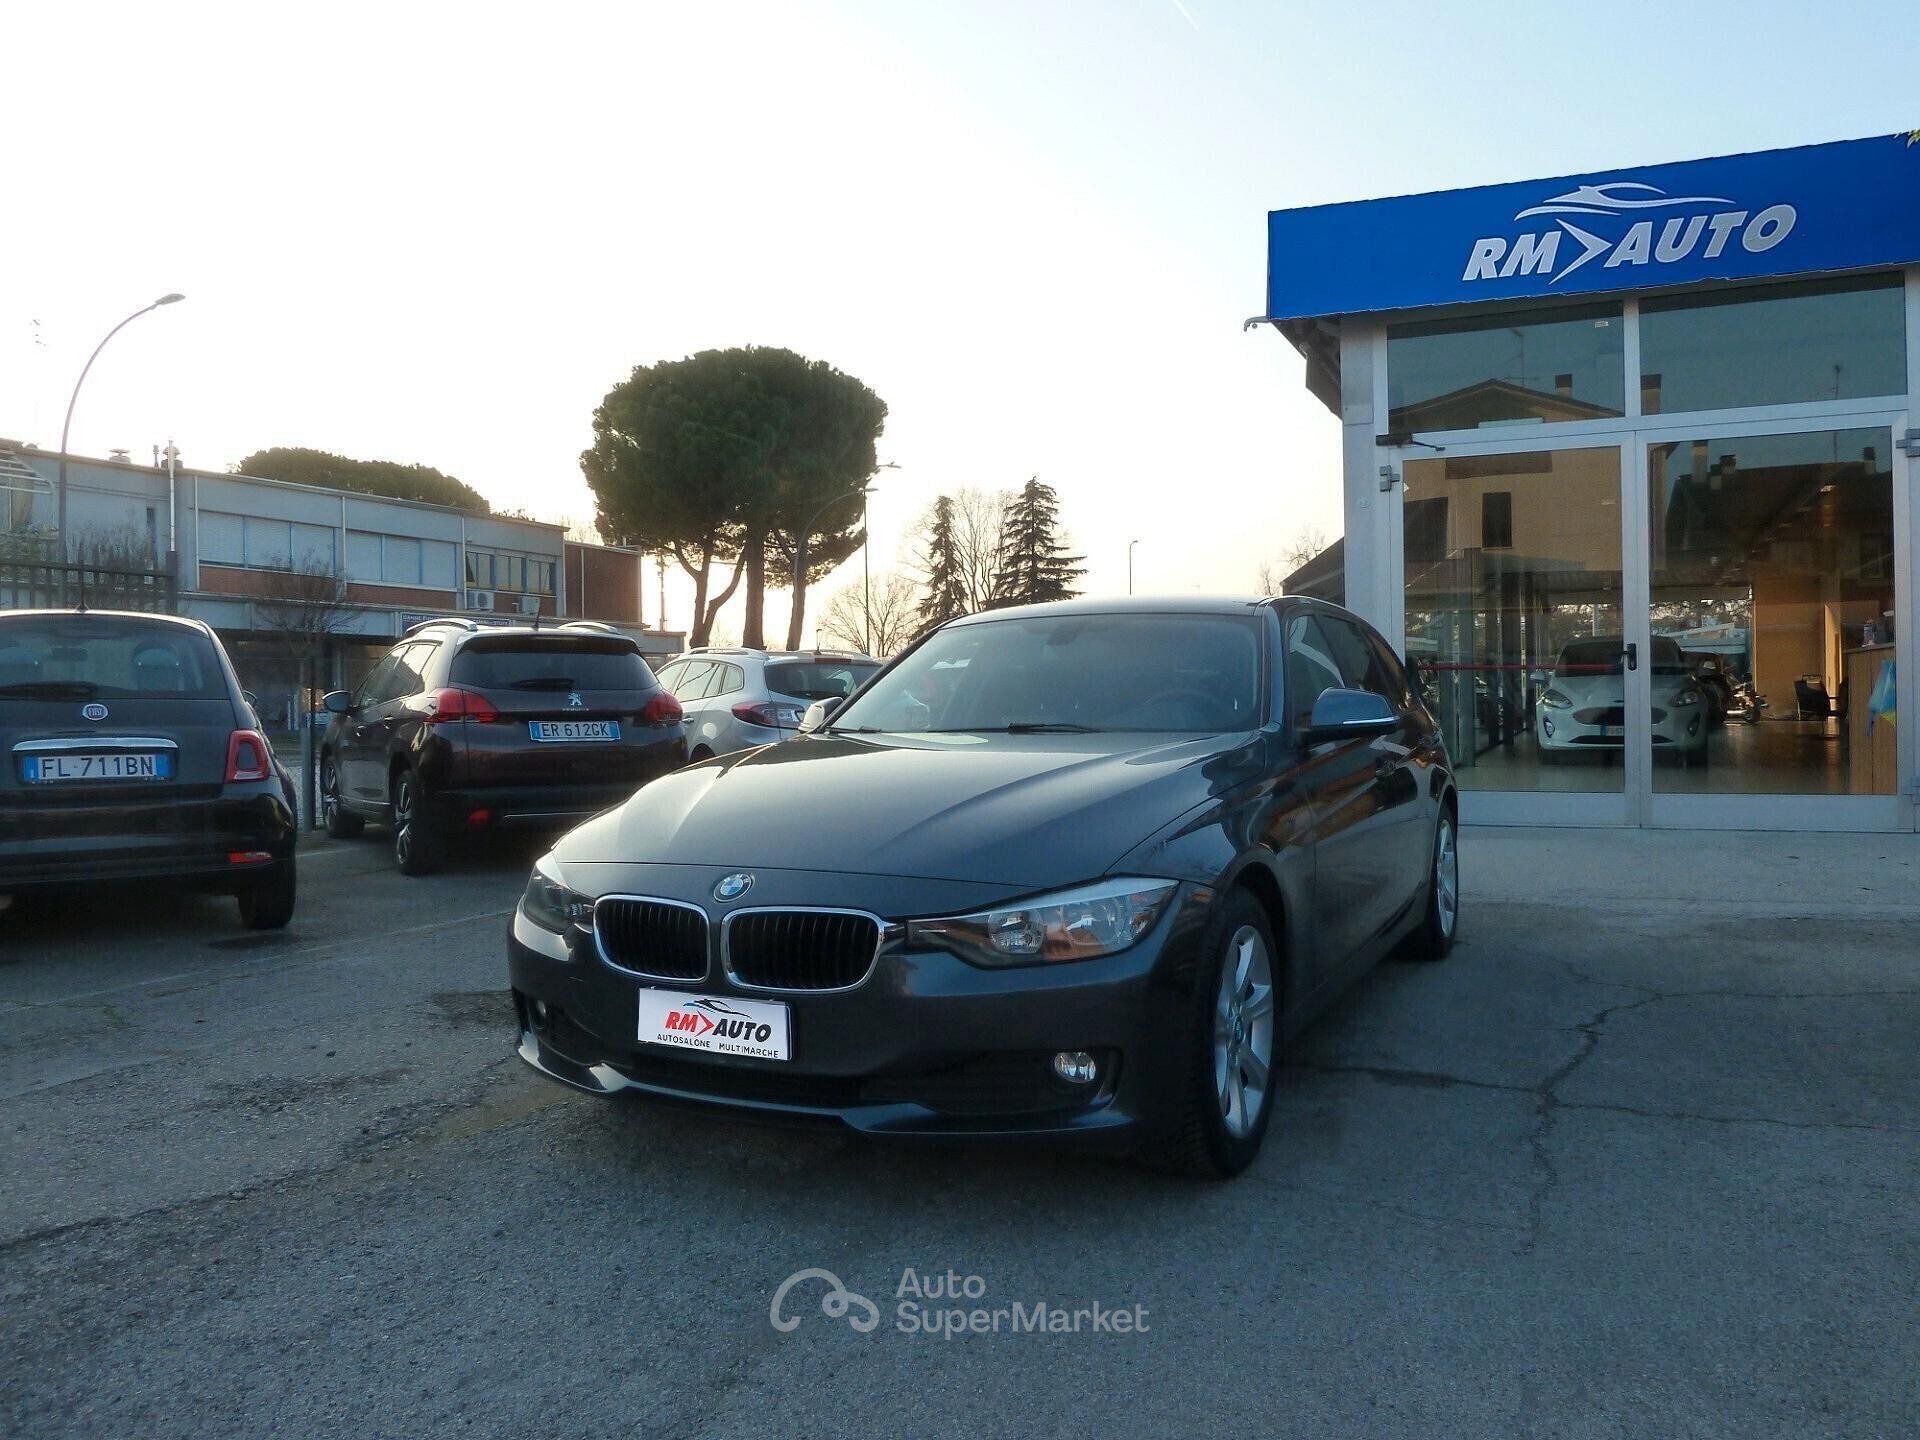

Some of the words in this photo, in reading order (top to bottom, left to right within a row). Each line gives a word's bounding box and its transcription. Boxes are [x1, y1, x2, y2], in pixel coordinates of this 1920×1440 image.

[1461, 231, 1562, 282] RM
[1602, 204, 1797, 268] AUTO
[541, 723, 559, 737] ER
[564, 723, 609, 737] 612GK
[42, 758, 71, 778] FL
[80, 756, 153, 777] 711BN
[665, 1011, 699, 1033] RM
[712, 1018, 772, 1043] AUTO
[657, 1033, 711, 1048] AUTOSALONE
[718, 1042, 779, 1059] MULTIMARCHE
